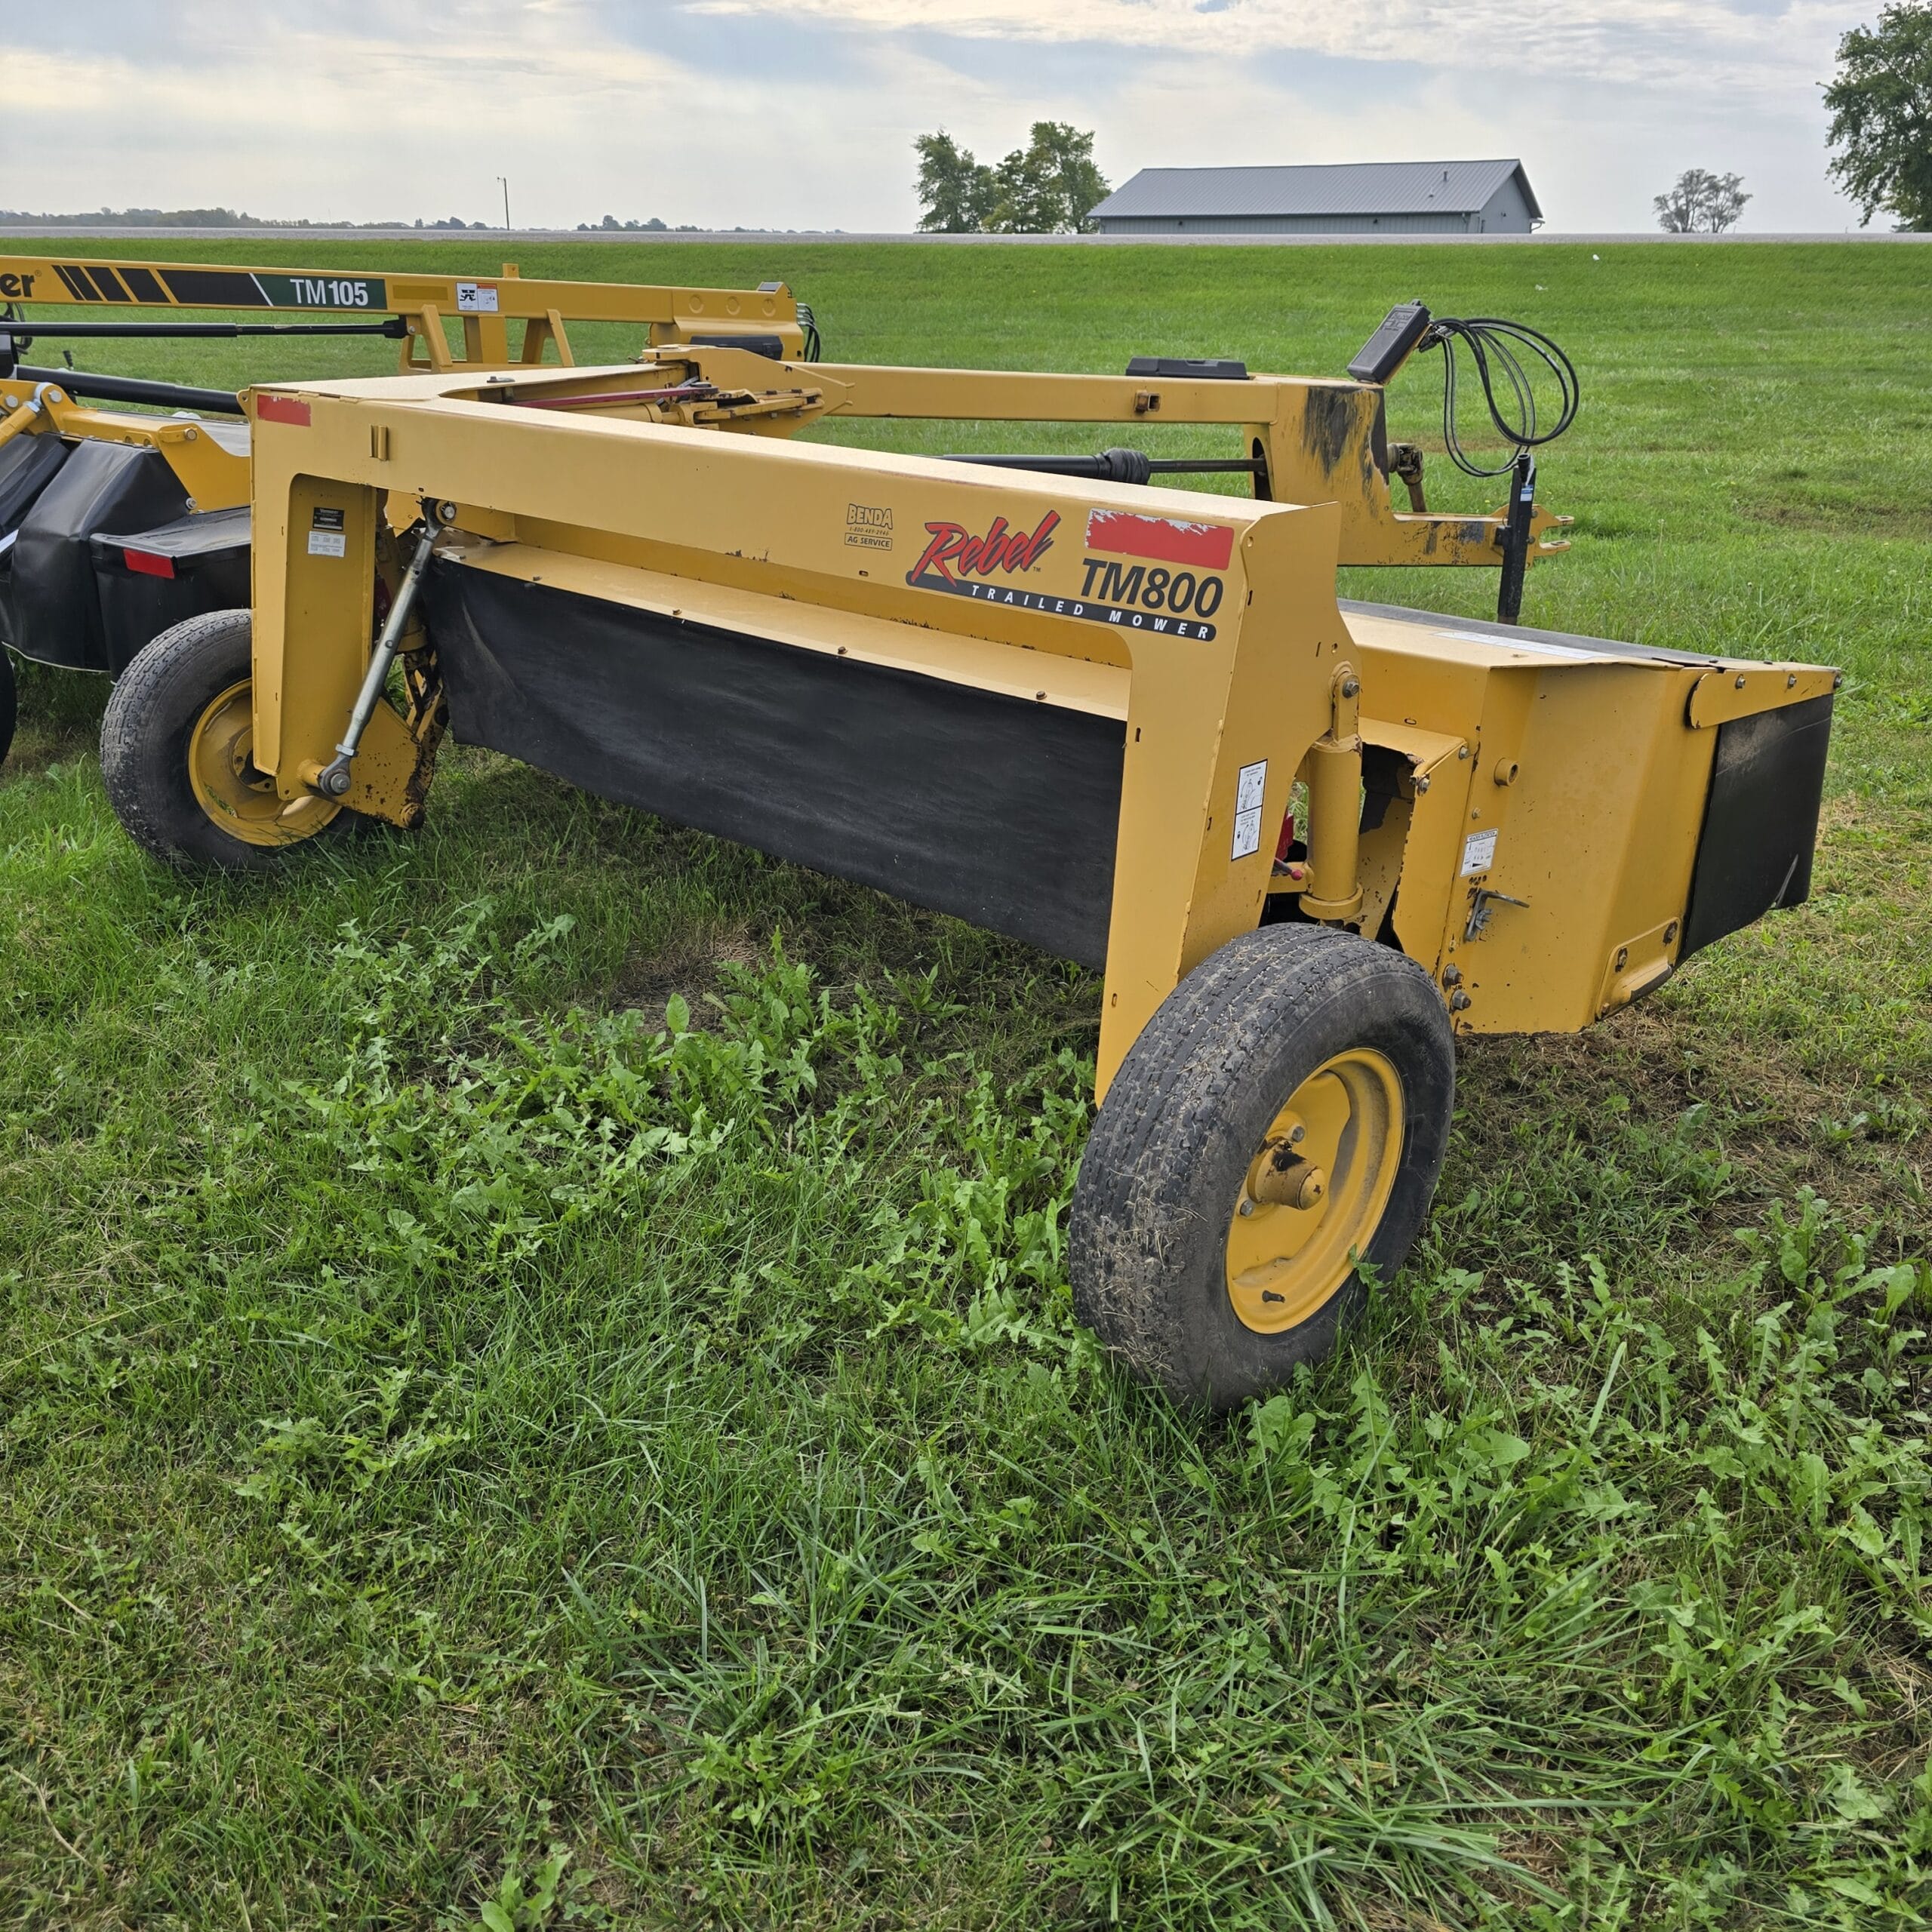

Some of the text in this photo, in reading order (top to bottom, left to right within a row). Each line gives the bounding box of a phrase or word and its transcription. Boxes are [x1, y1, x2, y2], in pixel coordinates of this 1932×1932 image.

[847, 503, 893, 530] BENDA
[860, 537, 891, 547] SERVICE
[911, 509, 1061, 587] Rebel
[971, 585, 1208, 639] TRAILED MOWER
[1081, 558, 1223, 618] TM800
